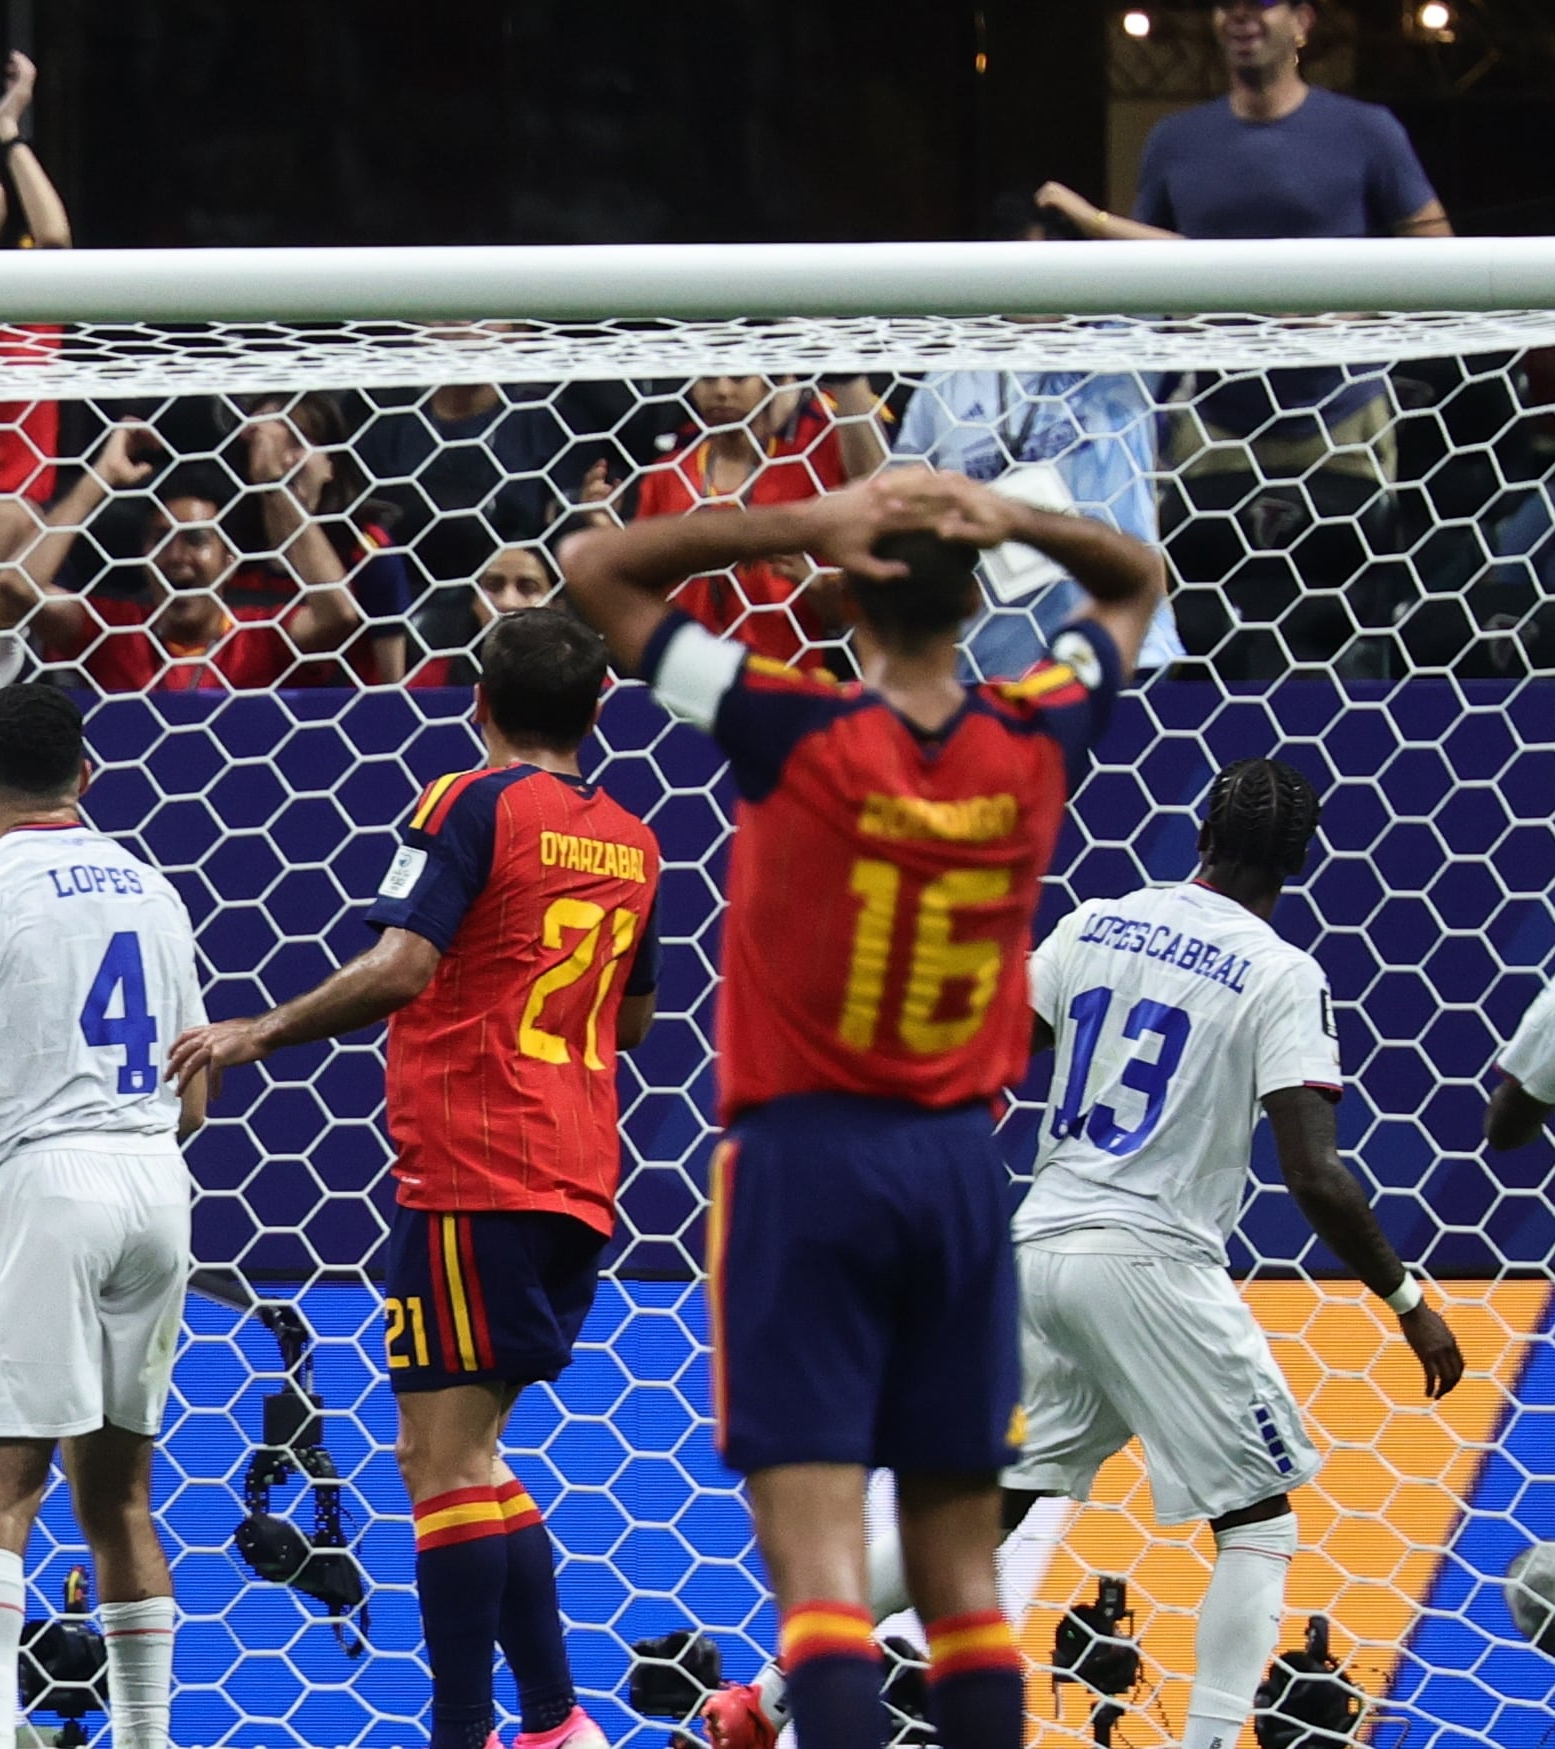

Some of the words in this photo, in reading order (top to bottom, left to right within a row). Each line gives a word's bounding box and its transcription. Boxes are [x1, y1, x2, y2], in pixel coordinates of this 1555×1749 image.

[48, 864, 144, 898] LOPES
[540, 831, 646, 883] OYARZABAL
[79, 931, 158, 1094] 4
[518, 897, 639, 1070] 21
[839, 859, 1011, 1055] 16
[1050, 985, 1192, 1157] 13
[384, 1296, 430, 1368] 21
